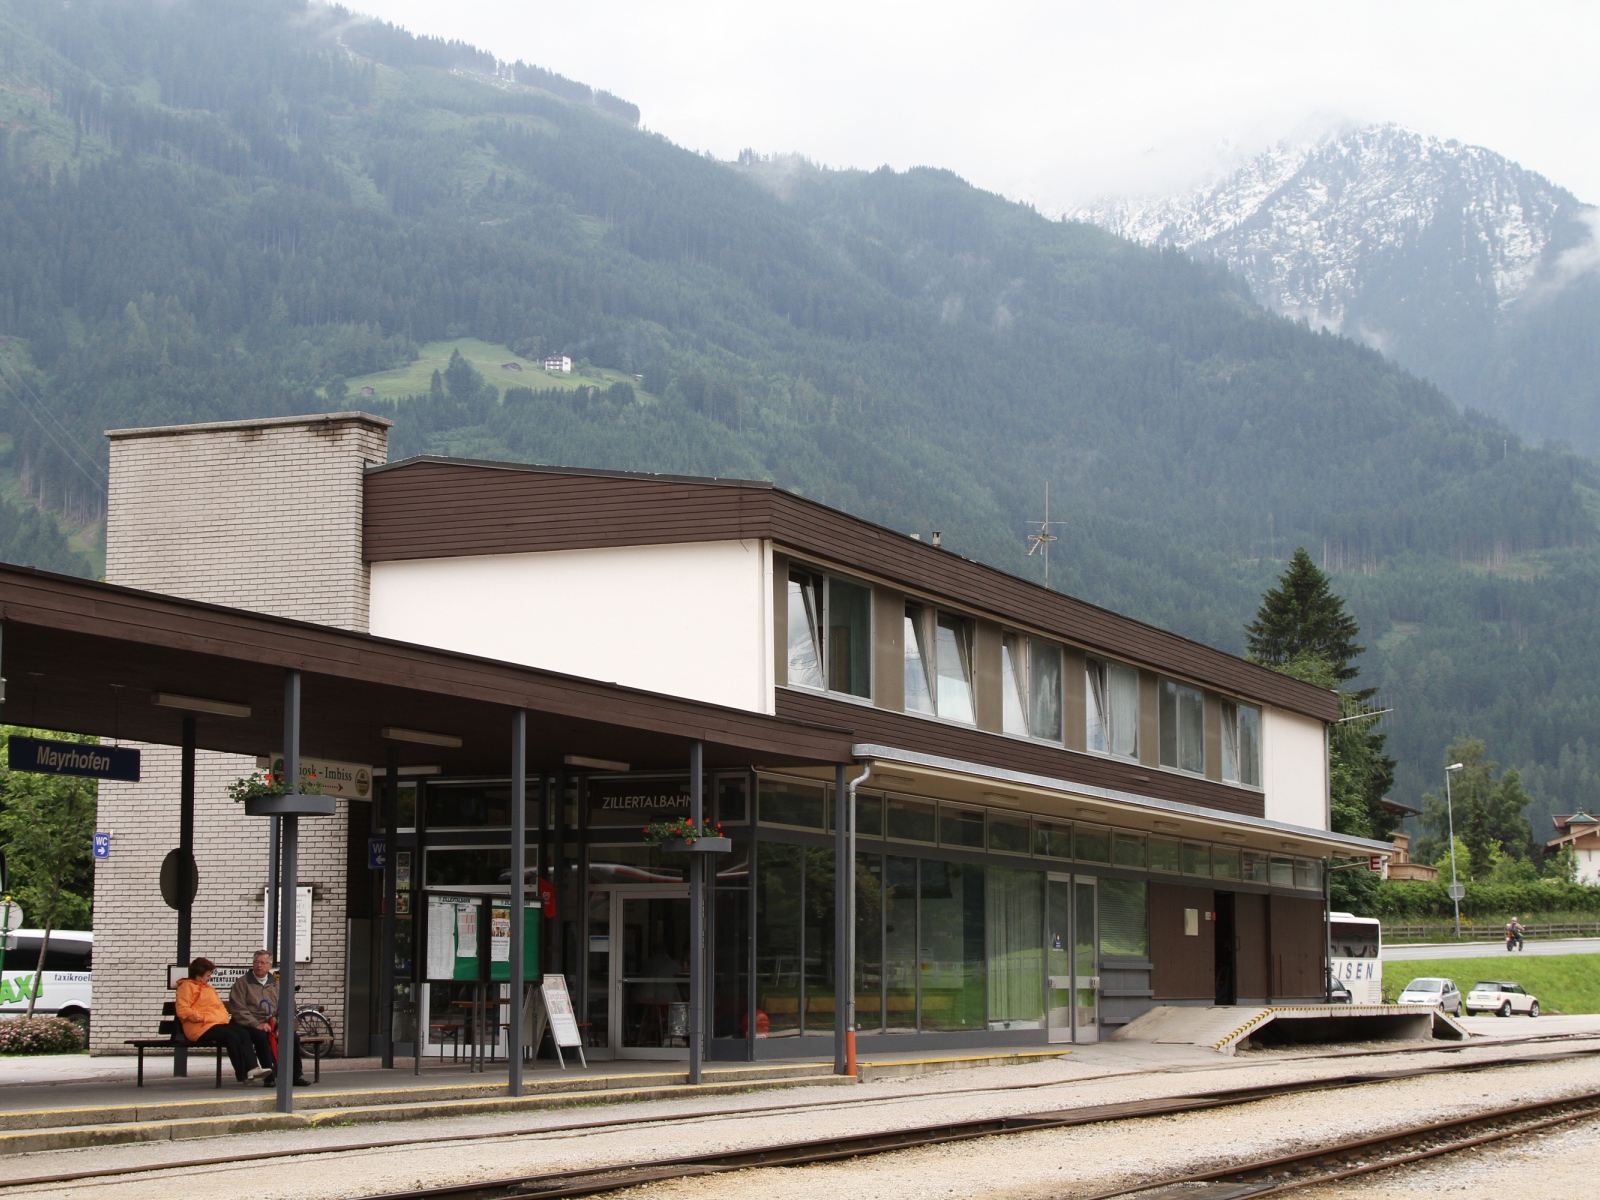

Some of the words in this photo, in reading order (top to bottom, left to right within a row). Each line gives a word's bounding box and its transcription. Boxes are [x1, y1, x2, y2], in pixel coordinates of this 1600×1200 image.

[36, 745, 110, 771] Mayrhofen
[299, 763, 317, 777] iosk
[324, 766, 352, 781] Imbiss
[95, 836, 108, 846] WC
[1369, 855, 1382, 871] E
[0, 974, 43, 1005] AXI
